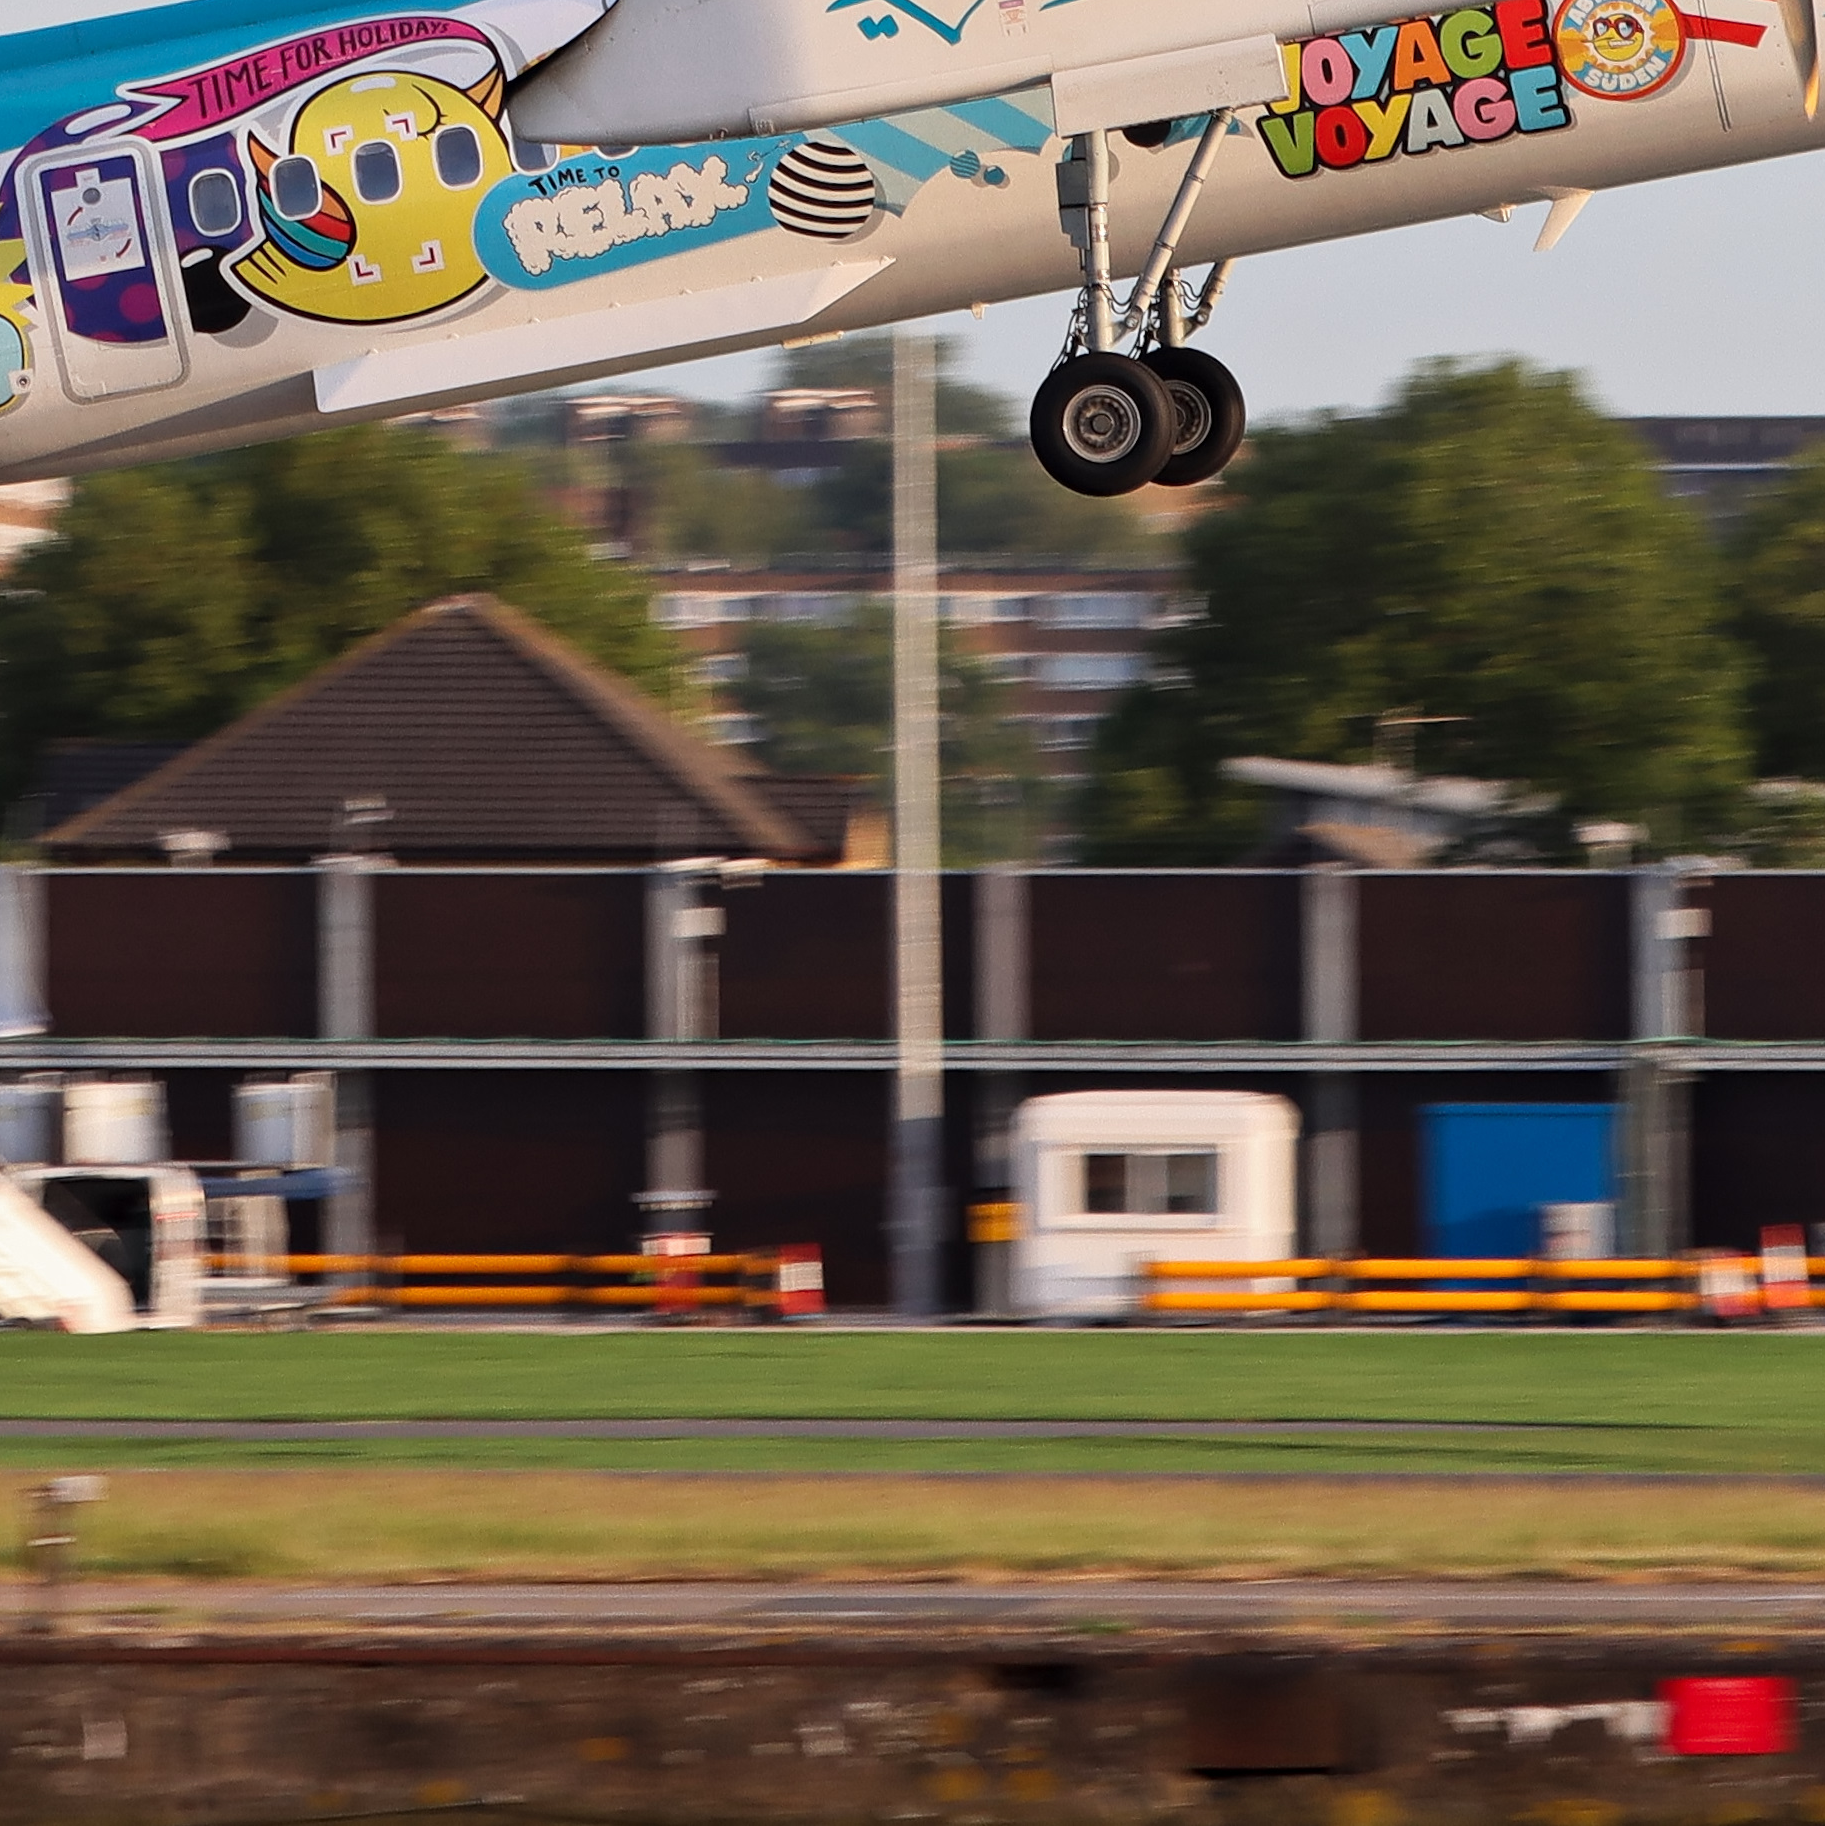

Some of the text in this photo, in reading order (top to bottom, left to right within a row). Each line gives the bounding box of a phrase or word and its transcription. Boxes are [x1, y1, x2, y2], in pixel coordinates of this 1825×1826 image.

[188, 19, 450, 119] TIME FOR HOLIDAYS
[1583, 54, 1667, 91] SÜDEN
[1261, 67, 1569, 177] VOYAGE
[504, 155, 750, 276] RELAX
[528, 165, 620, 196] TIME TO
